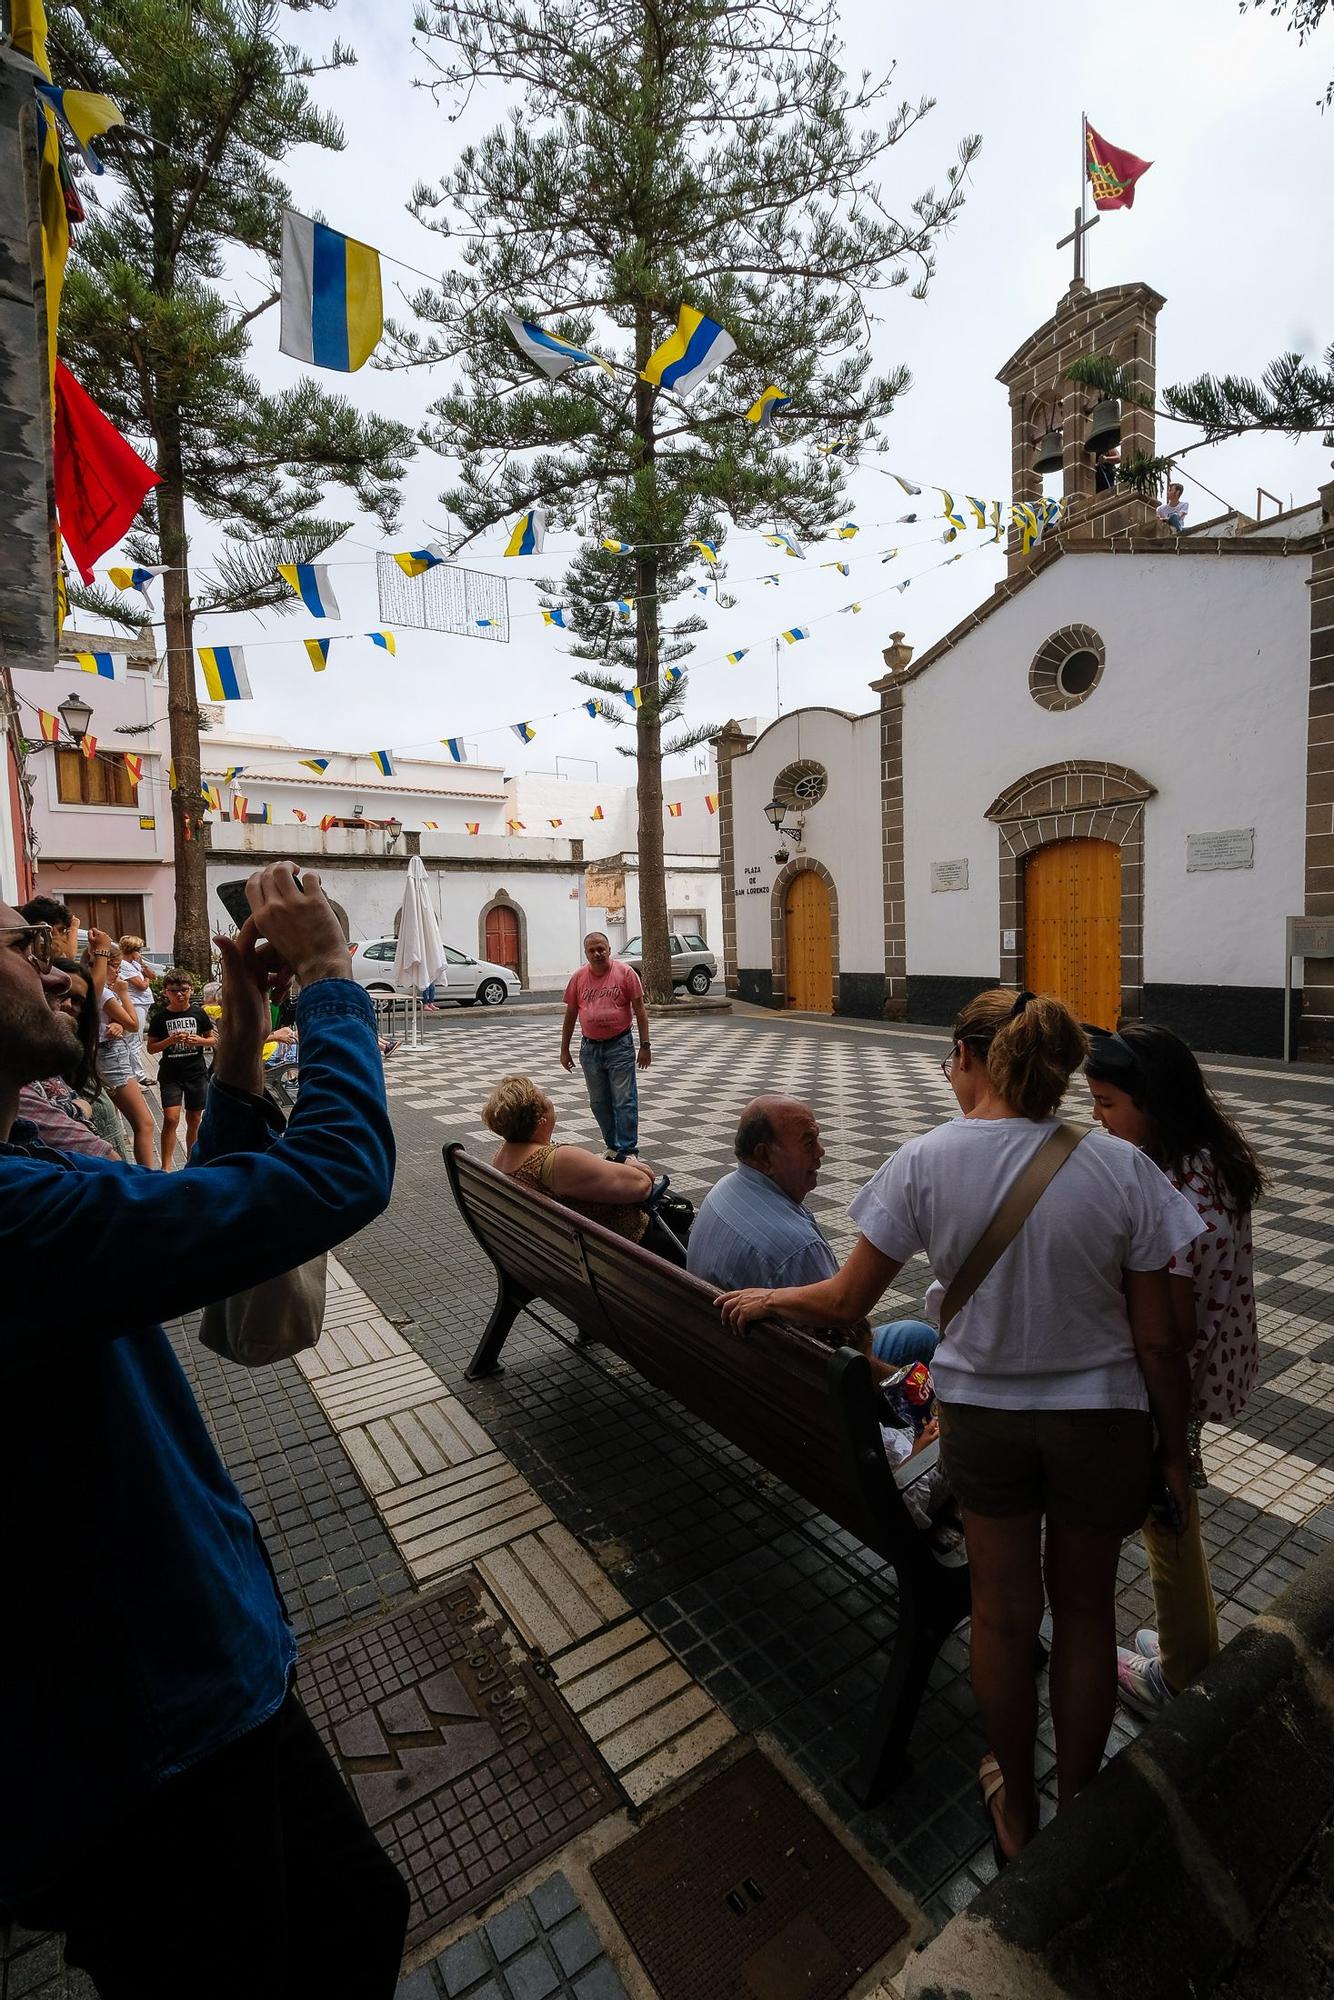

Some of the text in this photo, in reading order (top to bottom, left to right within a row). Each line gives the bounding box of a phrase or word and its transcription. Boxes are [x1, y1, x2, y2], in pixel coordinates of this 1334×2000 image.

[744, 866, 760, 874] PLAZA
[746, 886, 769, 895] LORENZO
[166, 1019, 196, 1030] HARLEM
